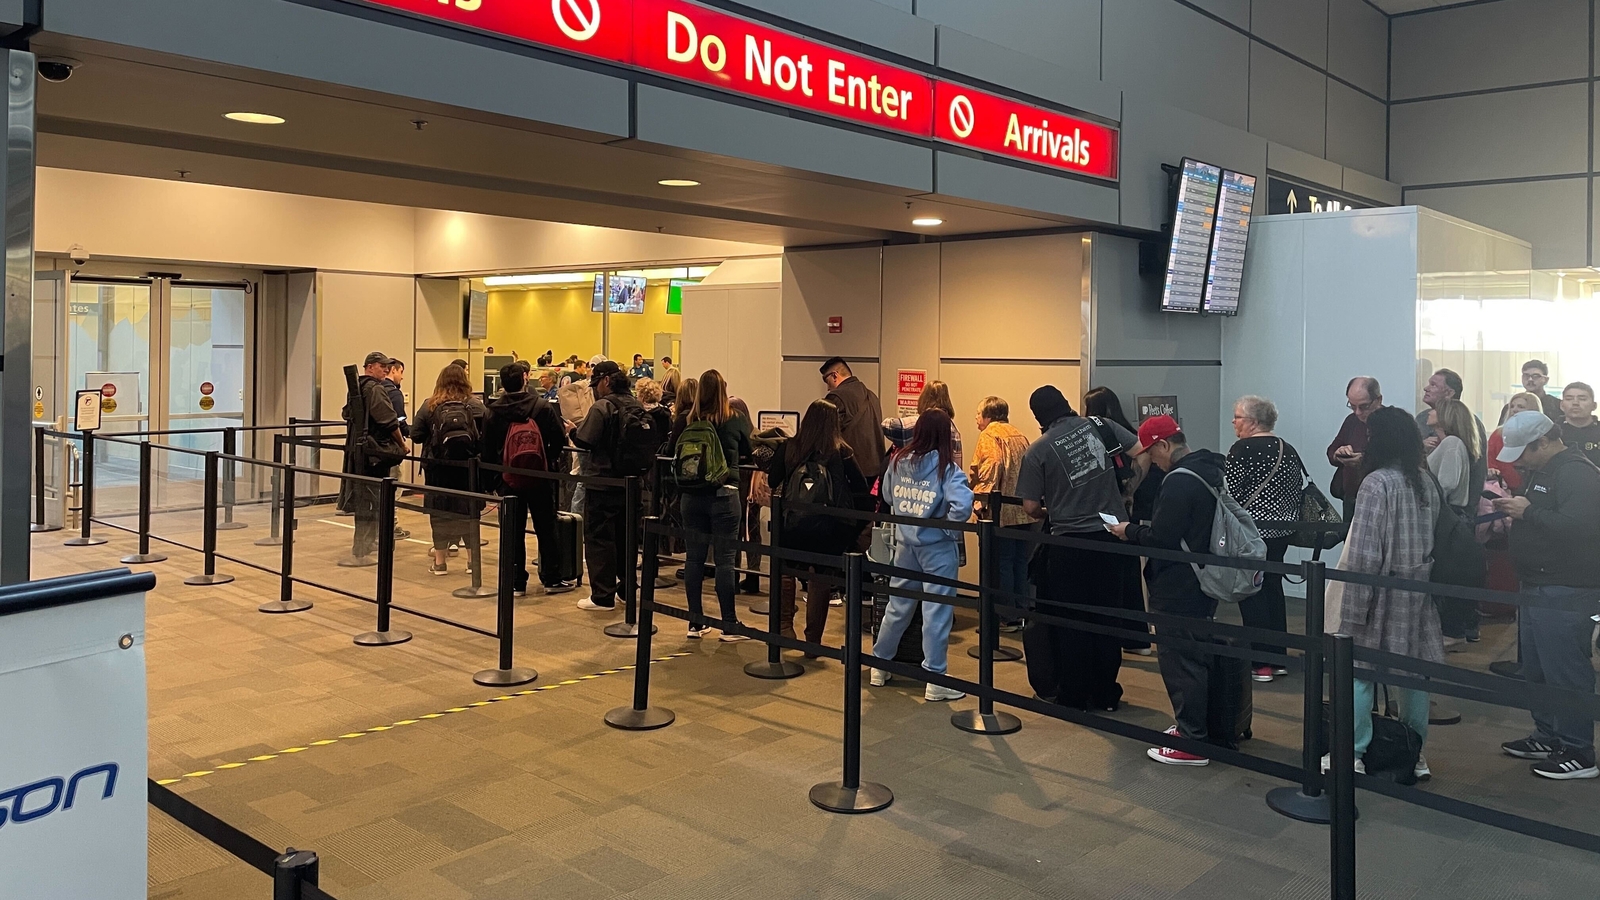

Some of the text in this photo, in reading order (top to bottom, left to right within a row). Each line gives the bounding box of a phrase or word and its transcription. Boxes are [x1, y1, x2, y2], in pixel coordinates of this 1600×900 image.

[667, 11, 912, 121] Do Not Enter
[1003, 113, 1090, 167] Arrivals
[1309, 195, 1322, 213] To
[900, 374, 924, 382] FIREWALL
[1160, 403, 1174, 416] Coffee
[1055, 436, 1071, 446] Don't
[1077, 424, 1092, 434] them
[1064, 442, 1075, 450] kill
[893, 484, 937, 504] COMFORT
